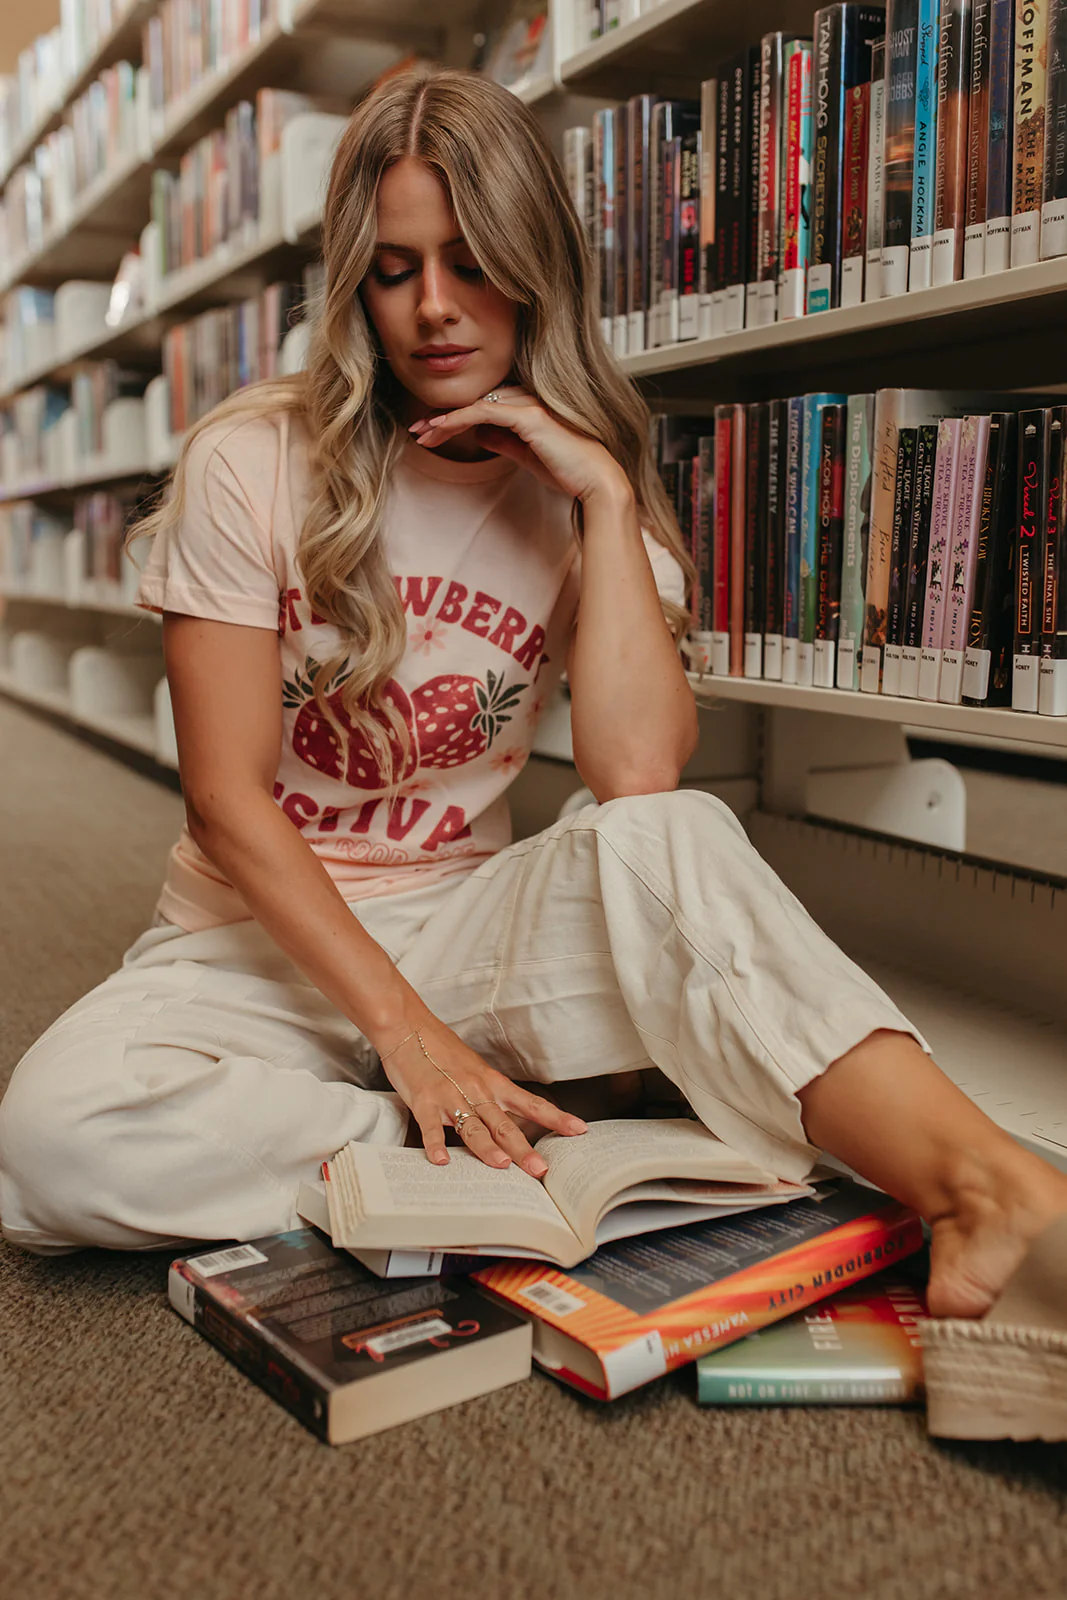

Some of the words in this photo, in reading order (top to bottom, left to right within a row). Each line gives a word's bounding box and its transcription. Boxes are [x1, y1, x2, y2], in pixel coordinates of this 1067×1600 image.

[818, 15, 831, 65] TAMI
[921, 22, 933, 66] Shipped
[940, 13, 954, 103] Hoffman
[973, 3, 988, 95] Hoffman
[1020, 0, 1035, 116] OFFMAN
[760, 44, 771, 108] CLARK
[816, 68, 829, 129] HOAG
[1057, 103, 1067, 128] THE
[917, 121, 928, 168] ANGIE
[970, 130, 980, 194] INVISIBLE
[1026, 129, 1036, 159] THE
[1055, 132, 1067, 176] WORLD
[758, 123, 770, 212] DIVISION
[815, 136, 828, 217] SECRETS
[874, 155, 882, 193] PARIS
[936, 137, 946, 202] INVISIBLE
[987, 227, 1010, 236] HOFFMAN
[769, 419, 779, 446] THE
[789, 409, 799, 469] EVERYONE
[851, 411, 863, 442] The
[768, 453, 778, 514] TWENTY
[823, 444, 832, 486] JACOB
[880, 443, 897, 492] Gifted
[895, 447, 905, 513] GENTLEWOMEN
[902, 468, 912, 500] LEAGUE
[914, 442, 924, 509] GENTLEWOMEN
[923, 464, 932, 498] LEAGUE
[943, 457, 952, 490] SECRET
[967, 457, 976, 490] SECRET
[788, 472, 798, 503] WHO
[847, 445, 861, 567] Displacements
[1023, 461, 1039, 520] Vexed
[1047, 477, 1061, 523] Vexed
[788, 507, 797, 534] CAN
[821, 489, 831, 527] HOLO
[934, 496, 942, 535] TREASON
[941, 492, 950, 528] SERVICE
[957, 497, 965, 537] TREASON
[964, 493, 973, 530] SERVICE
[980, 487, 993, 534] BROKEN
[892, 513, 902, 552] WITCHES
[912, 510, 922, 549] WITCHES
[977, 535, 989, 560] VOW
[1019, 525, 1036, 538] 2
[1047, 525, 1057, 535] 3
[820, 535, 829, 566] THE
[1047, 552, 1055, 572] THE
[1021, 551, 1030, 595] TWISTED
[1046, 574, 1054, 606] FINAL
[910, 601, 918, 628] INDIA
[950, 608, 958, 635] INDIA
[1020, 598, 1029, 626] FAITH
[812, 1235, 906, 1285] FORBIDDEN
[768, 1284, 805, 1312] CITY
[682, 1310, 749, 1350] VANESSA
[727, 1383, 753, 1399] NOT
[758, 1383, 777, 1399] ON
[821, 1383, 846, 1399] BUT
